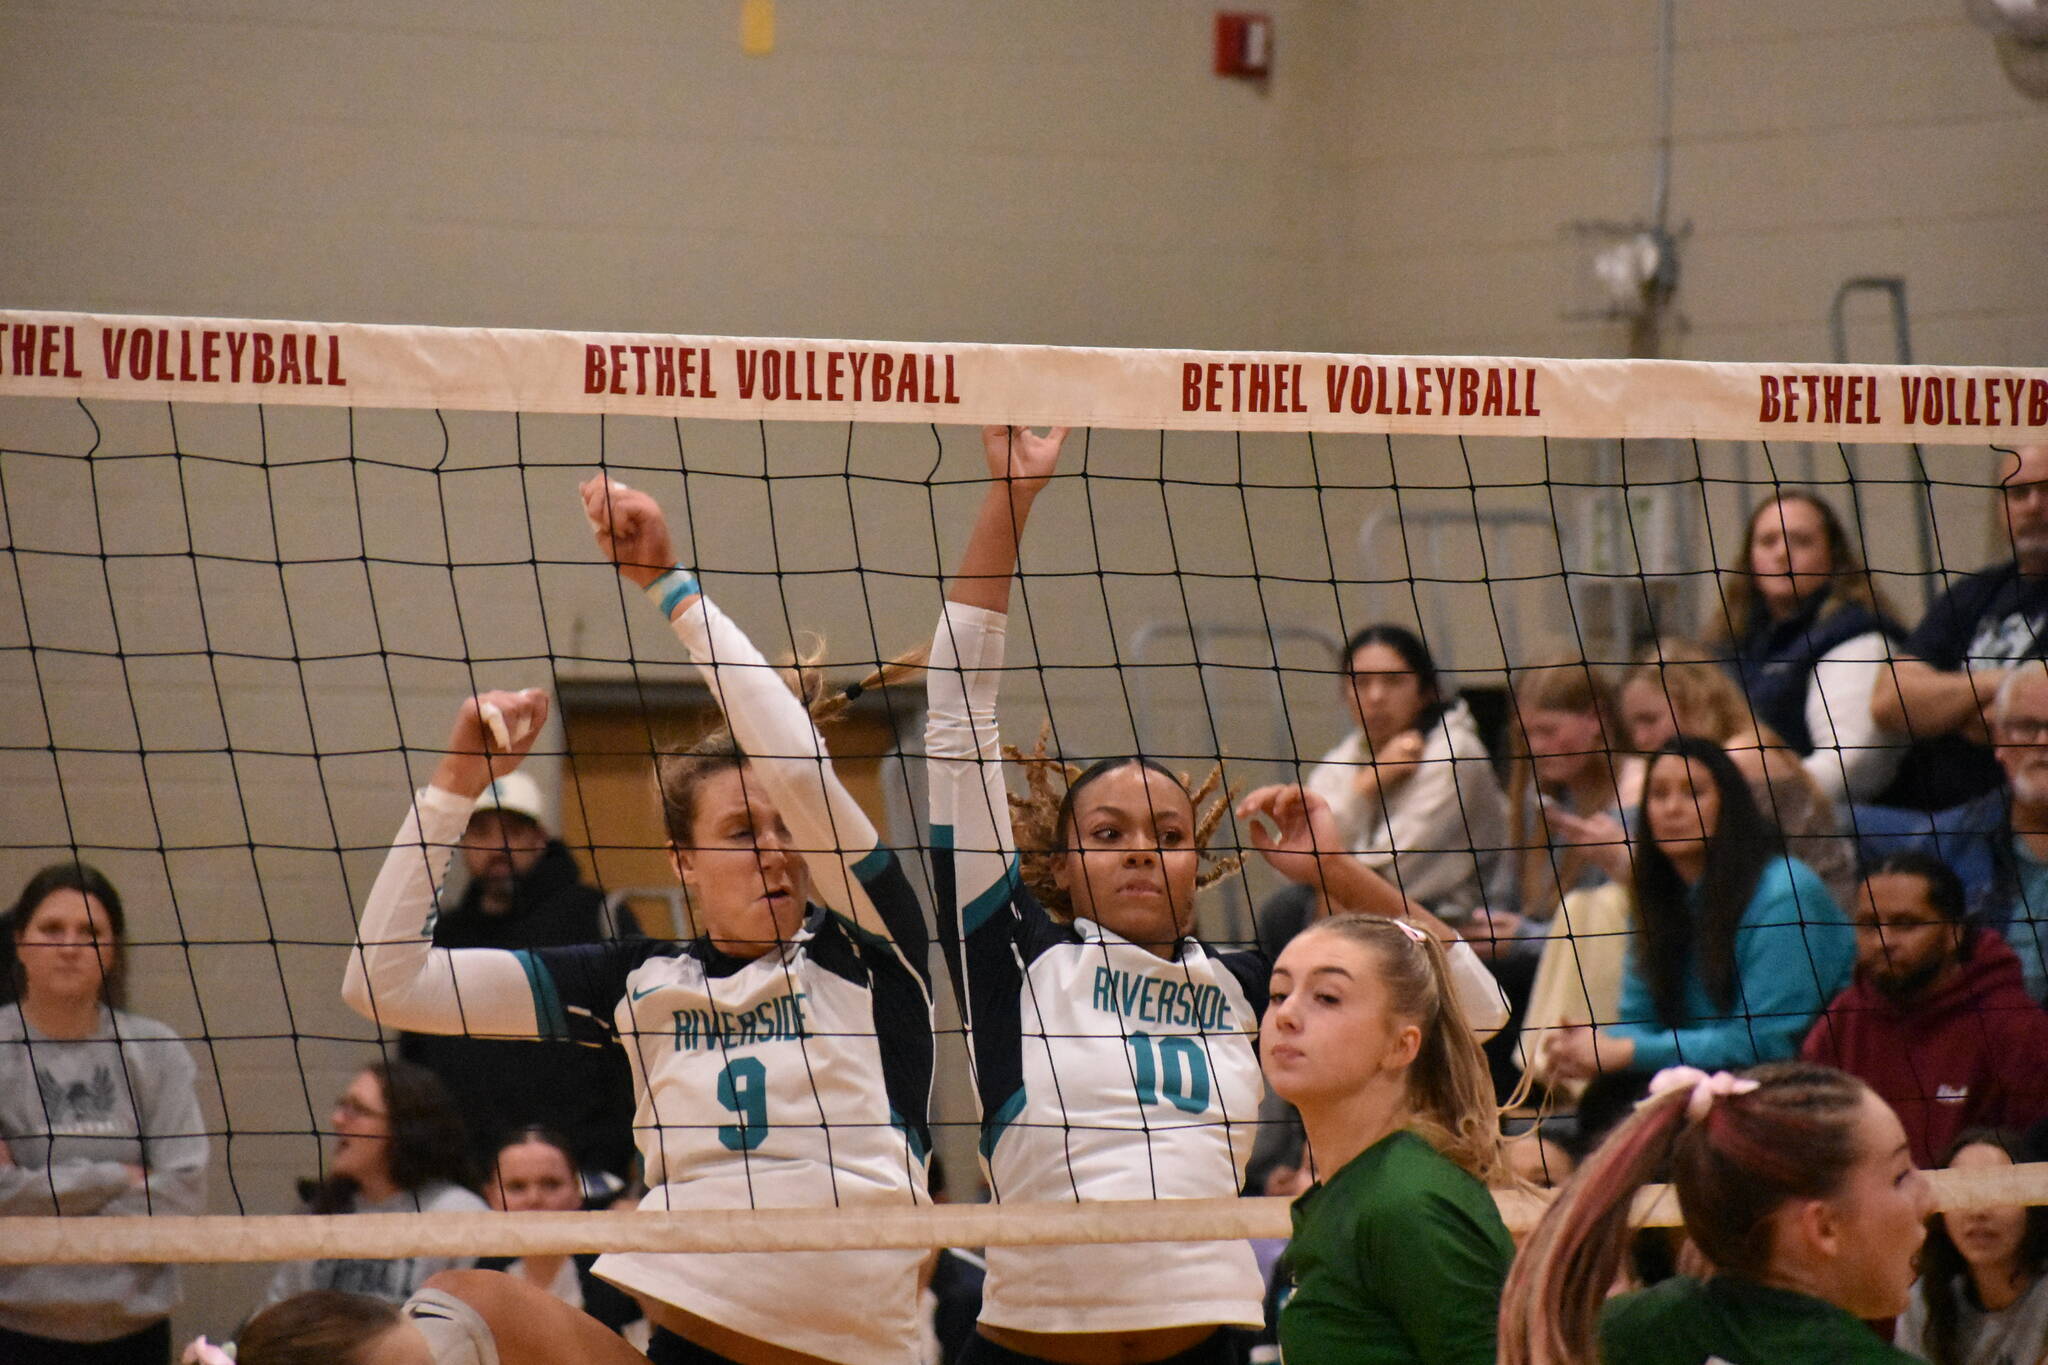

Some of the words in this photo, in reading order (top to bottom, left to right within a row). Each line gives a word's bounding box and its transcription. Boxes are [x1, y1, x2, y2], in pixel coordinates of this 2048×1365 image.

[102, 327, 347, 387] VOLLEYBALL
[584, 343, 717, 399] BETHEL
[736, 349, 960, 404] VOLLEYBALL
[1182, 362, 1308, 413] BETHEL
[1326, 364, 1541, 417] VOLLEYBALL
[1759, 375, 1882, 425] BETHEL
[1900, 376, 2048, 427] VOLLEYB
[672, 993, 813, 1051] RIVERSIDE
[1093, 966, 1234, 1031] RIVERSIDE
[1127, 1030, 1210, 1115] 10
[717, 1056, 768, 1151] 9
